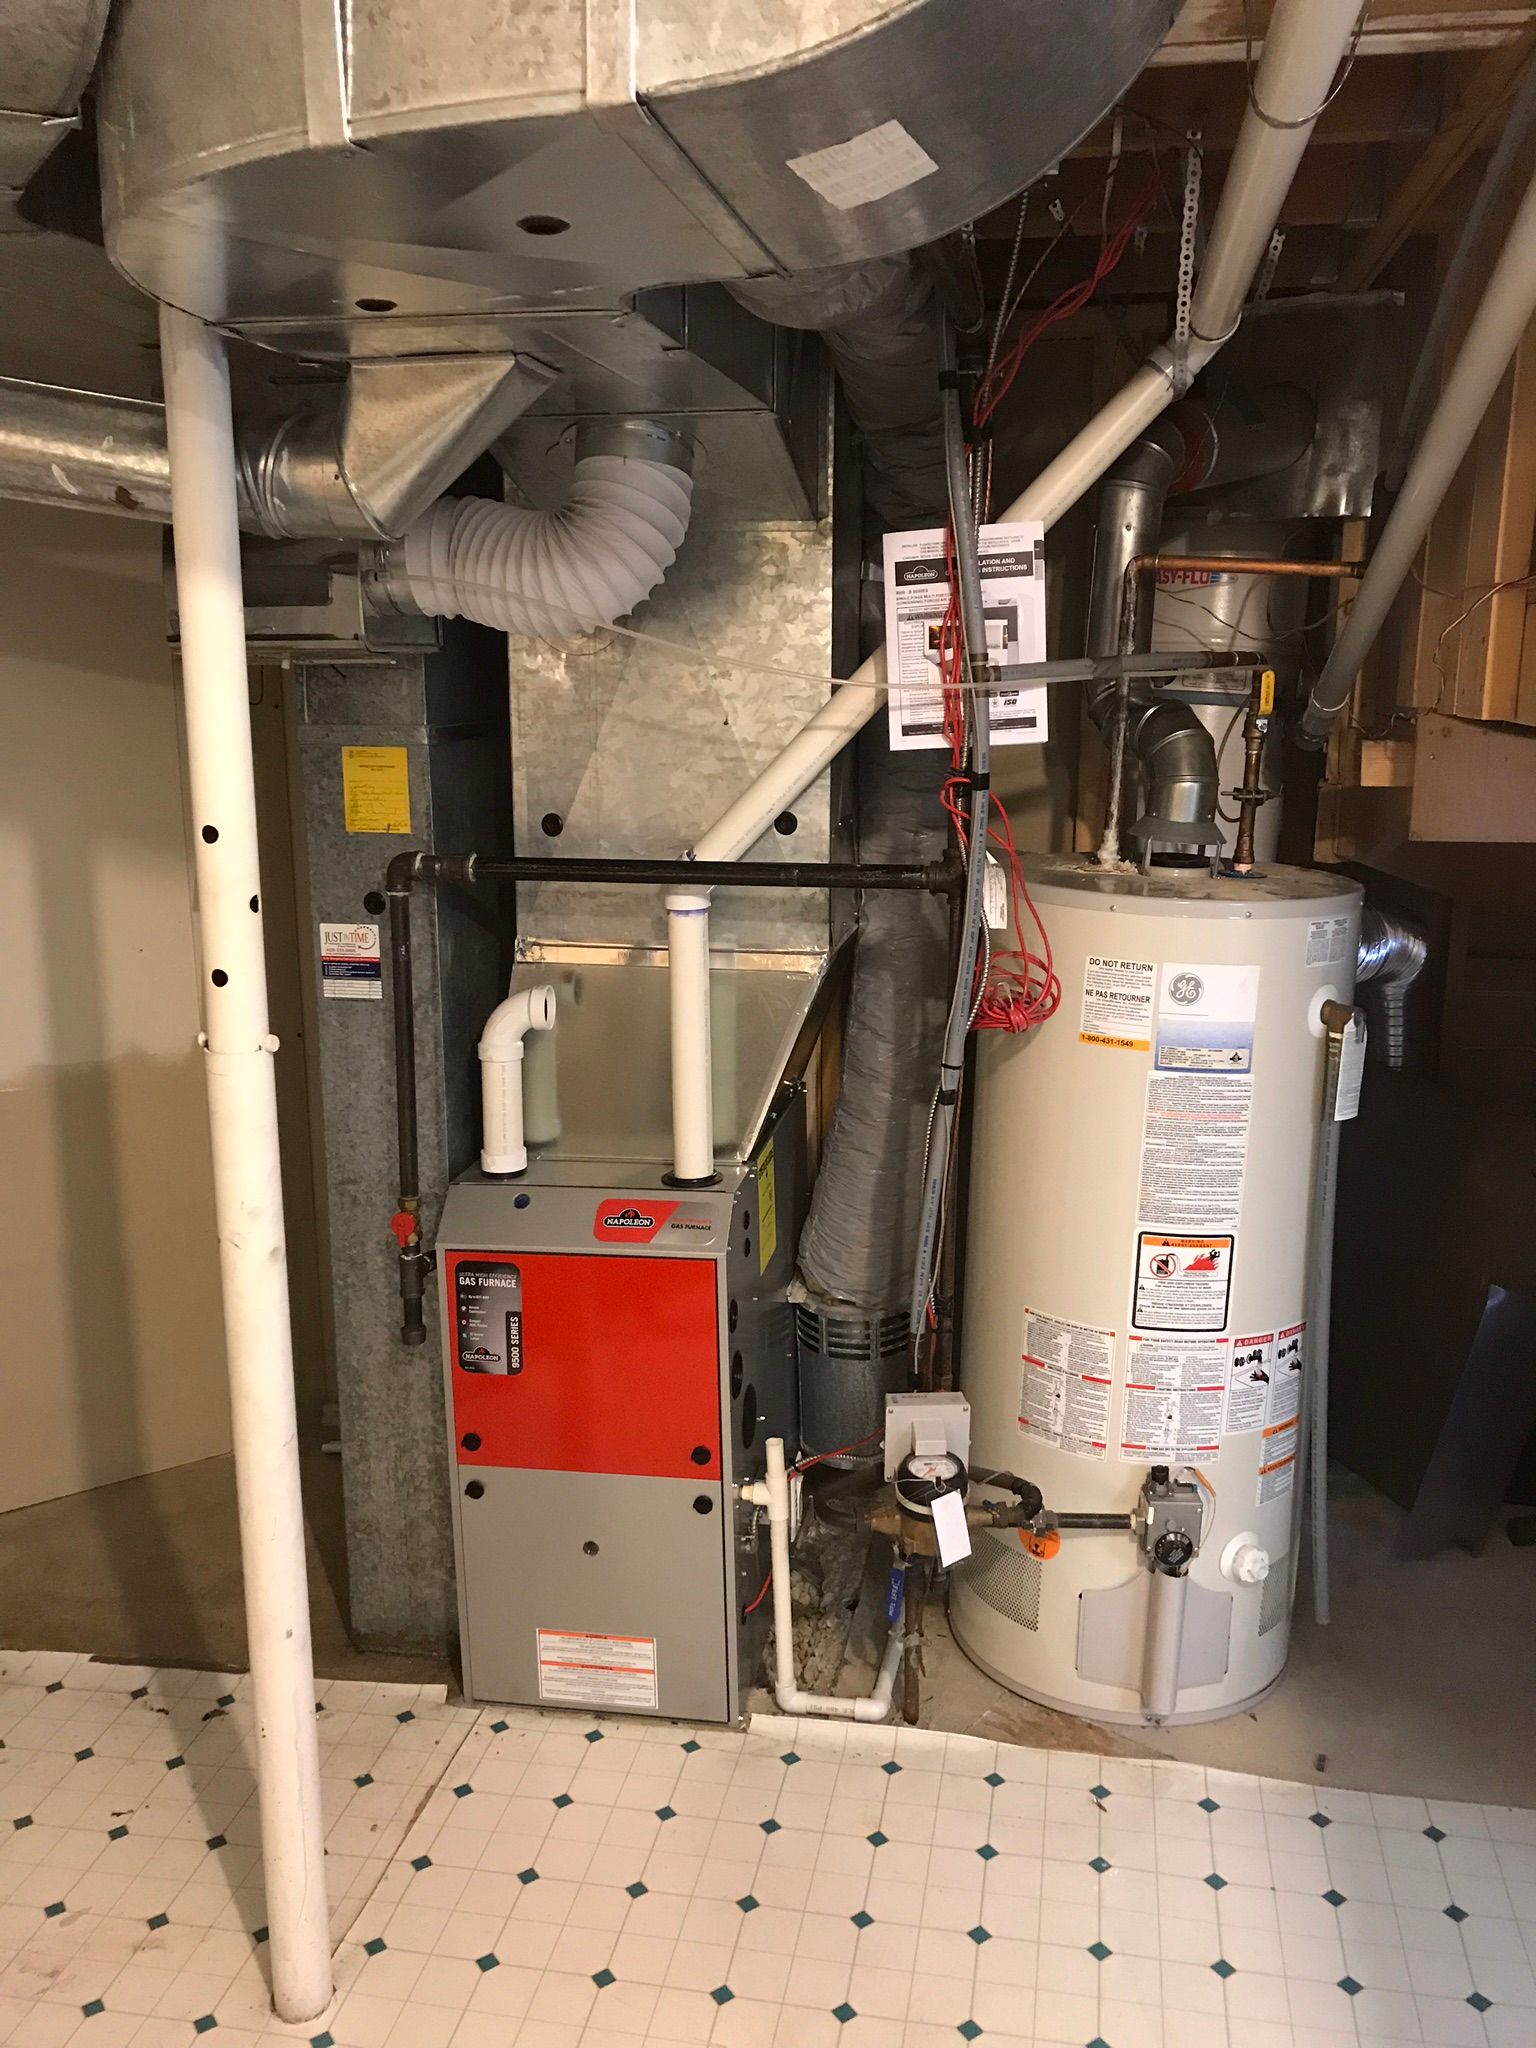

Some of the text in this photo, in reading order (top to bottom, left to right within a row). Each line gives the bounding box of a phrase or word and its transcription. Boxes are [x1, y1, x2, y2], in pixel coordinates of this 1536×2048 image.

[978, 558, 1001, 566] LATION
[981, 564, 1028, 573] INSTRUCTIONS
[906, 572, 936, 580] NAPOLEON
[324, 931, 343, 945] JUST
[349, 932, 370, 944] TIME
[1089, 957, 1153, 972] DO NOT RETURN
[1085, 988, 1151, 1004] NE PAS RETOURNER
[1081, 1034, 1134, 1048] 1-800-431-1549
[606, 1218, 651, 1227] NAPOLEON
[685, 1223, 711, 1231] FURNACE
[459, 1276, 517, 1288] GAS FURNACE
[510, 1316, 520, 1369] 9500 SERIES
[1244, 1335, 1272, 1346] DANGER
[465, 1353, 499, 1361] NAPOLEON
